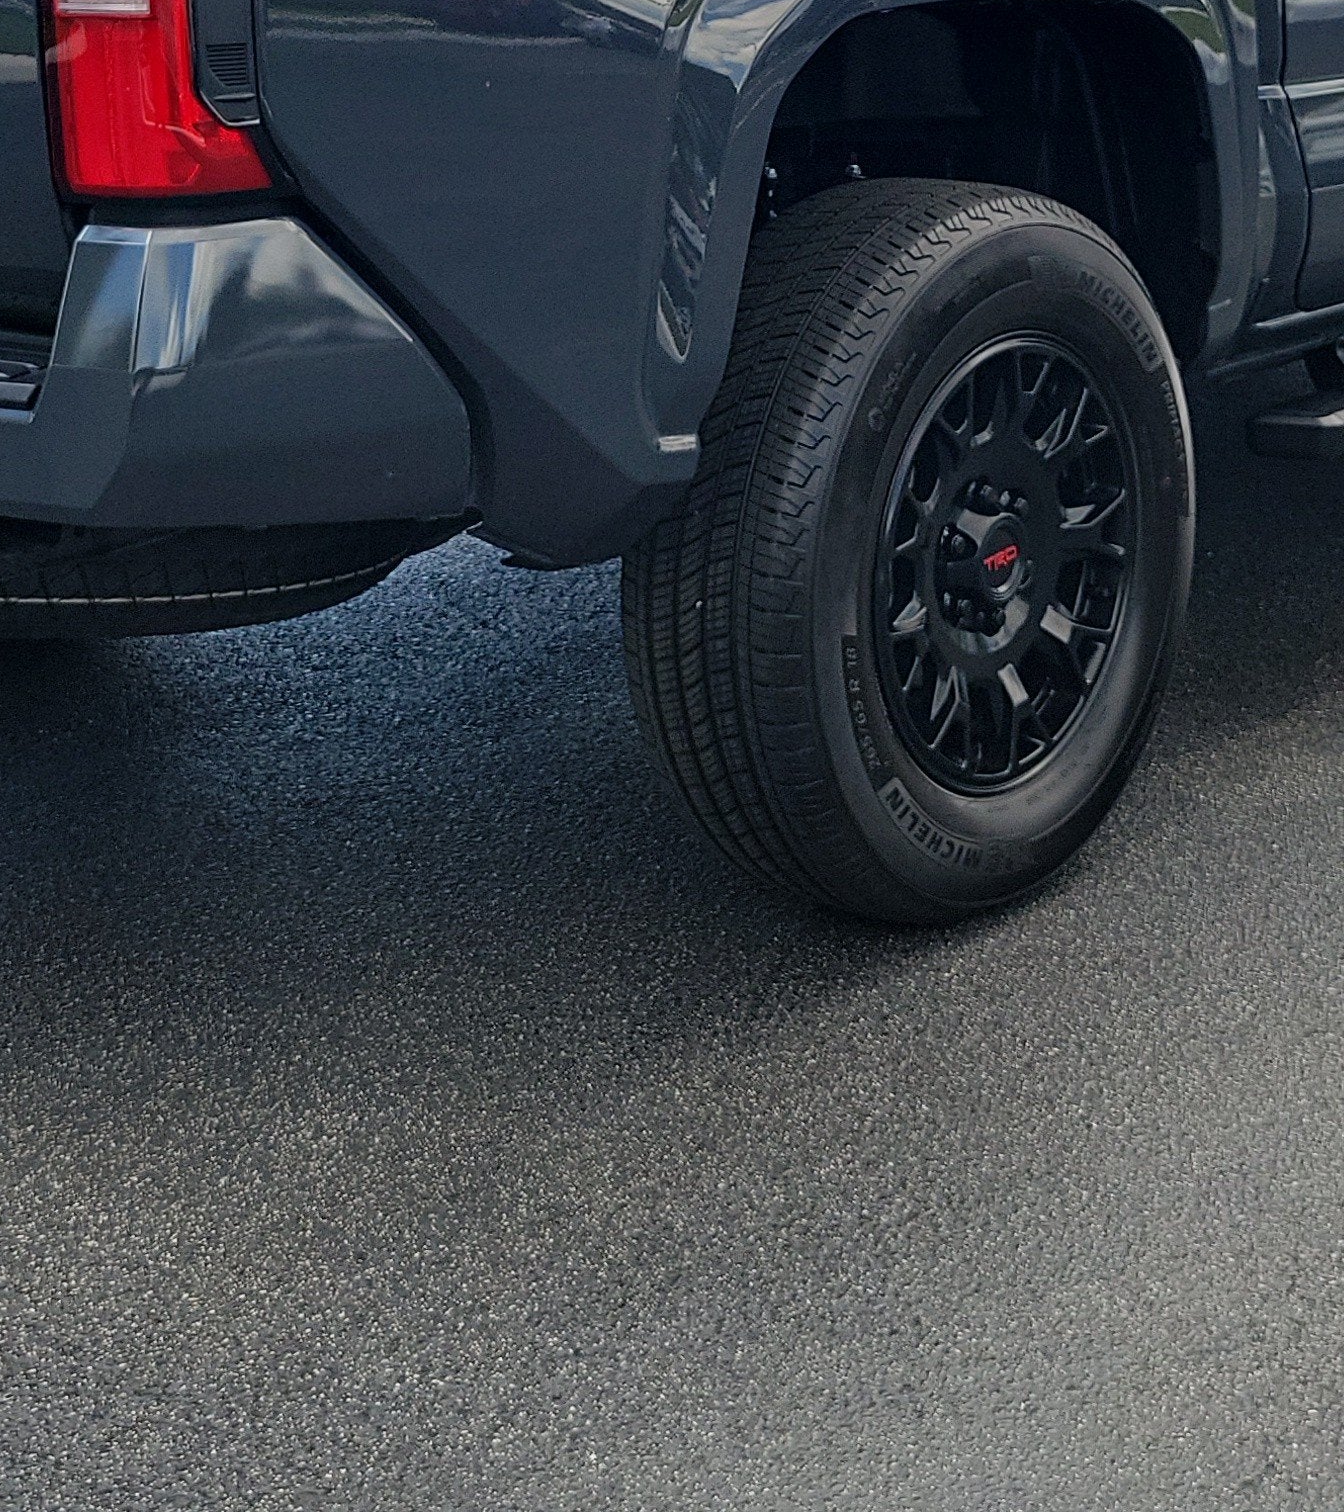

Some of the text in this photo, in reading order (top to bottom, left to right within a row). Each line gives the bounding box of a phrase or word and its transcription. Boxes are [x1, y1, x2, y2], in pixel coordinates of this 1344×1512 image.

[1078, 270, 1159, 364] MICHELIN
[983, 544, 1019, 570] TRD
[887, 786, 983, 867] MICHELIN
